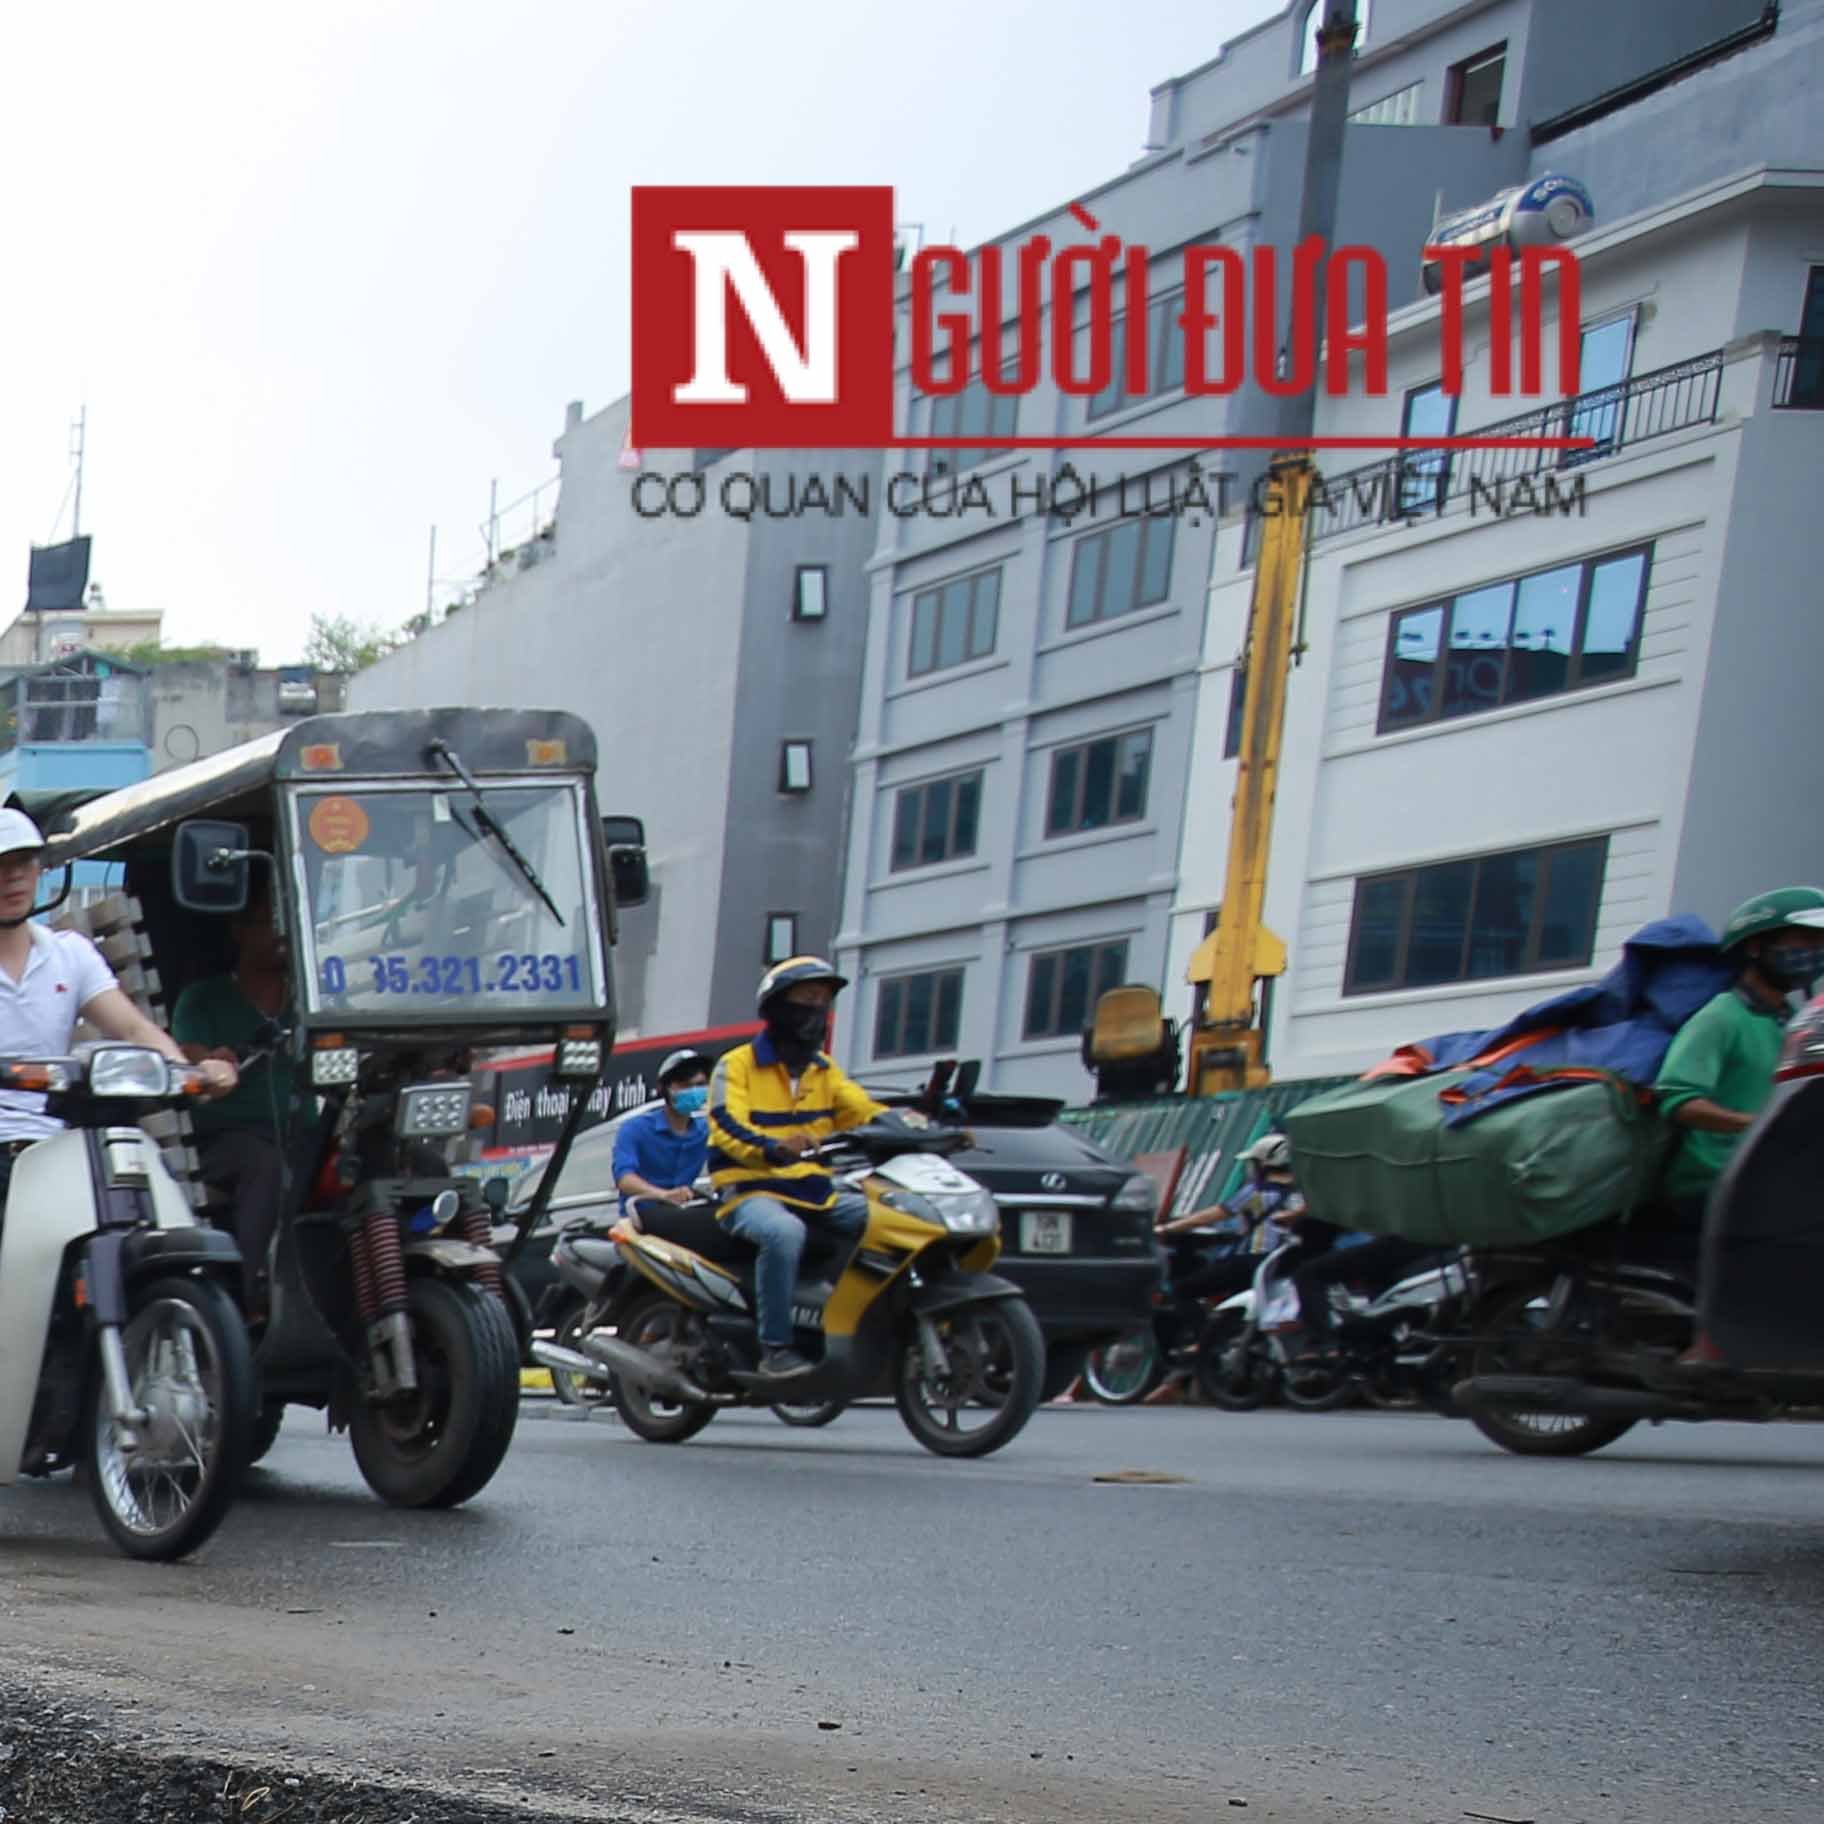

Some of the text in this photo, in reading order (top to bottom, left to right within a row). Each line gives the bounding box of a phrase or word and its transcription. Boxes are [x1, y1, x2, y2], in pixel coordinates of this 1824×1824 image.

[504, 1072, 647, 1127] Điện thoại áy tính
